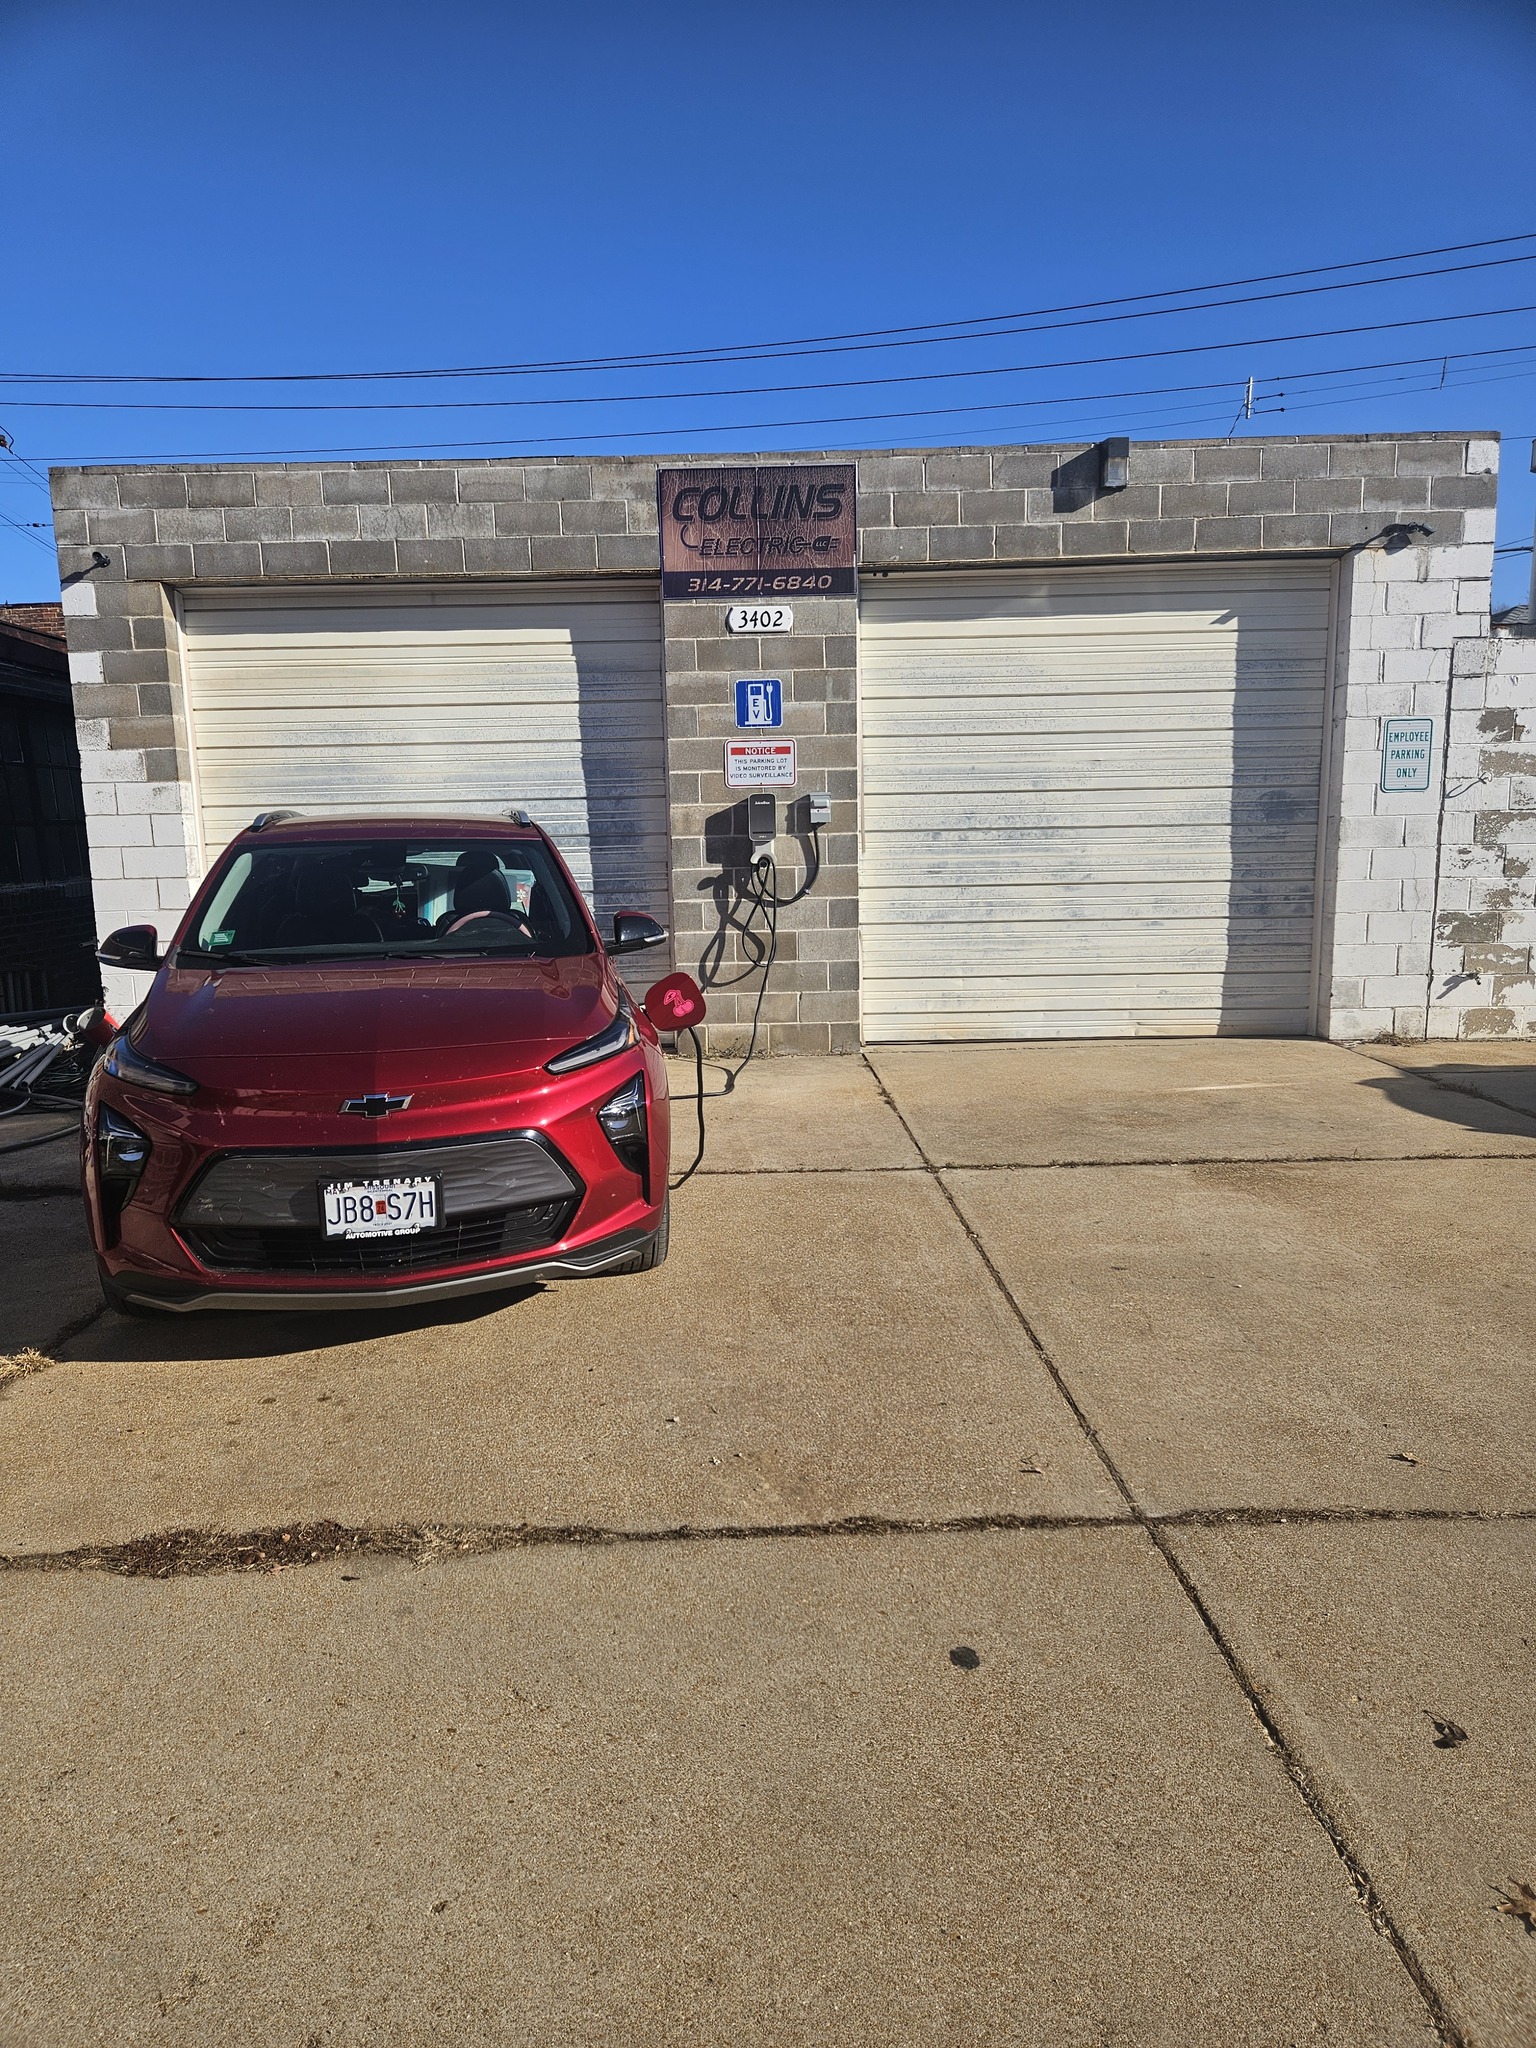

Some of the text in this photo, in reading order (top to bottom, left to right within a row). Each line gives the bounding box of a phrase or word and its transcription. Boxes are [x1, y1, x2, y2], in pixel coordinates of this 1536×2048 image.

[672, 483, 845, 522] COLLINS
[699, 535, 806, 556] ELECTRIC
[688, 575, 833, 593] 314-771-6840
[738, 610, 783, 628] 3402
[1388, 731, 1429, 742] EMPLOYEE
[745, 746, 777, 755] NOTICE
[1390, 749, 1425, 760] PARKING
[1396, 768, 1418, 778] ONLY
[327, 1176, 432, 1190] JIM TRENARY
[327, 1190, 434, 1225] JB8 S7H
[345, 1227, 421, 1240] AUTOMOTIVE GROUP
